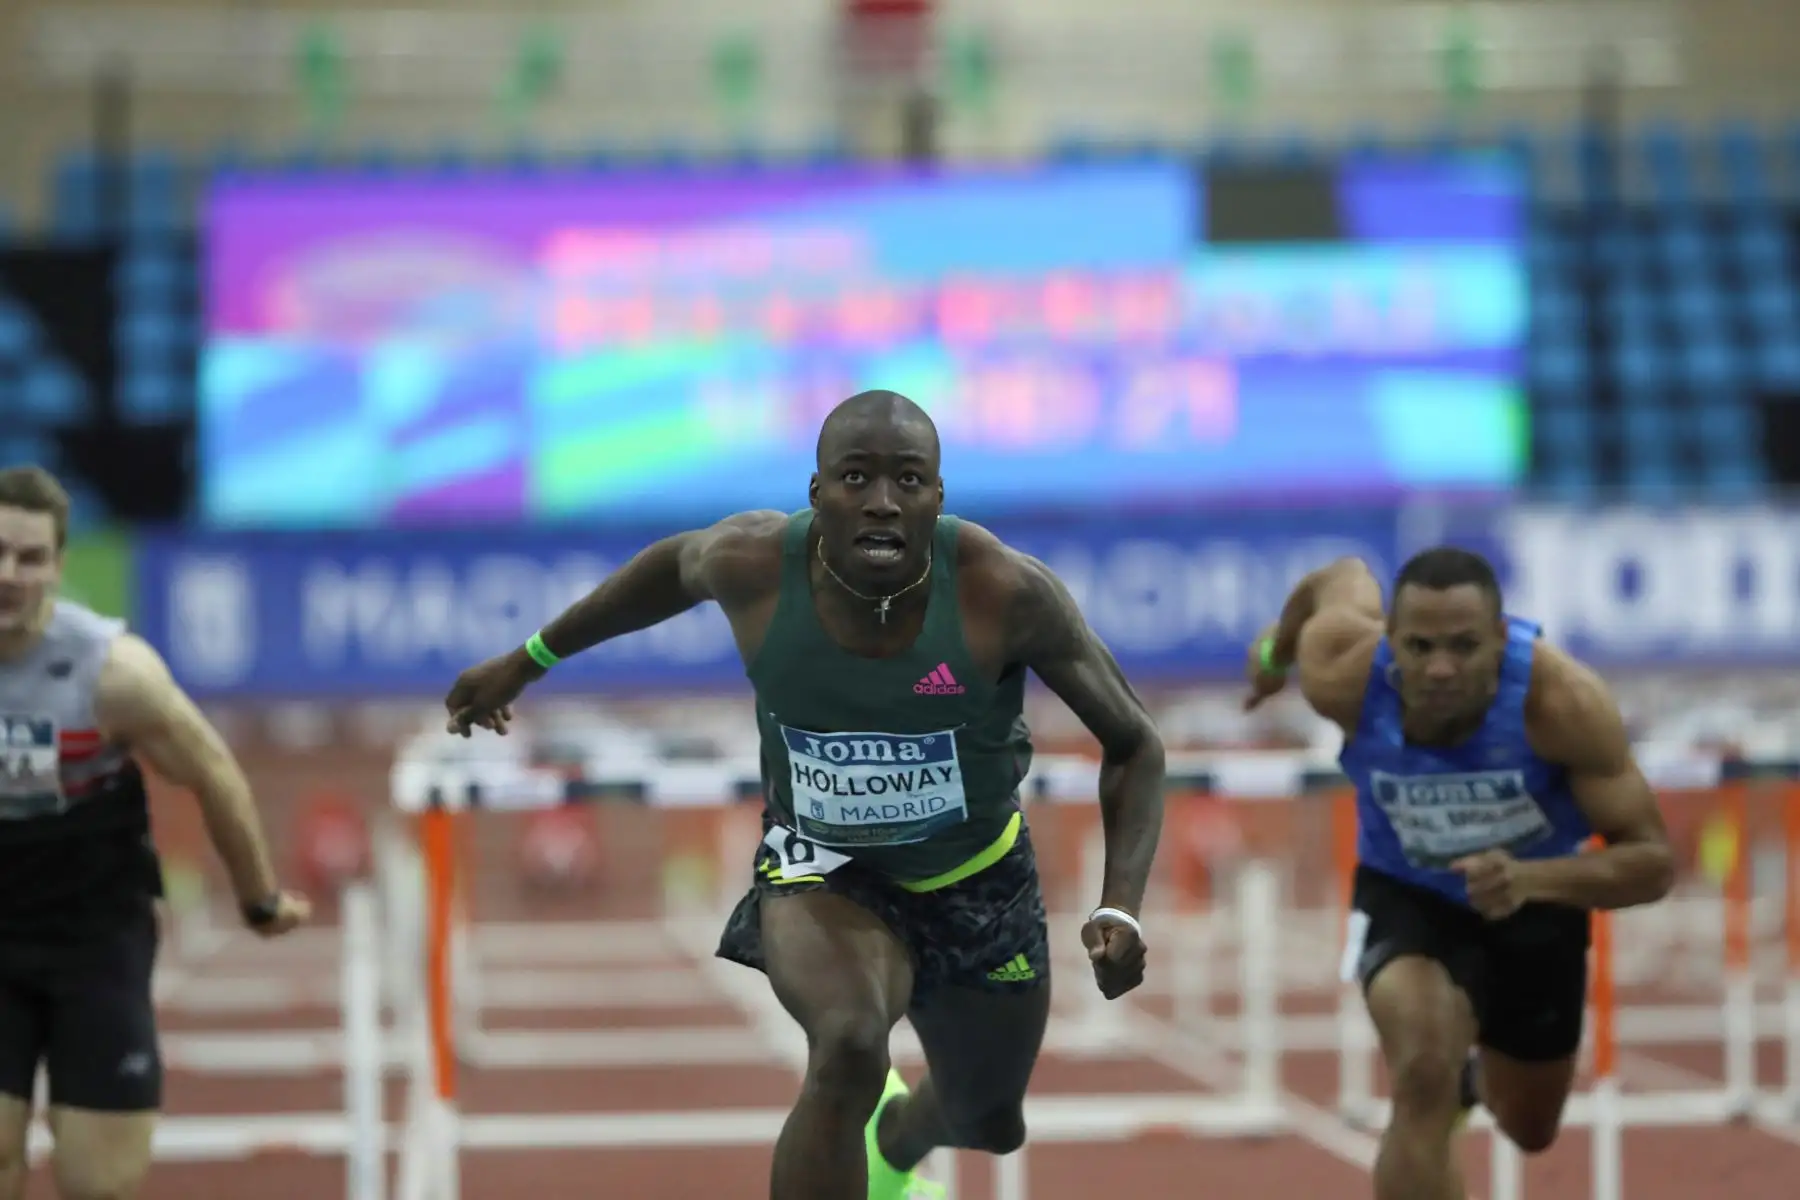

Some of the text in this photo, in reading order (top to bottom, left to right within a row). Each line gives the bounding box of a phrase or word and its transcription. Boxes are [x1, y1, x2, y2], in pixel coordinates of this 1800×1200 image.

[912, 683, 966, 695] adidas
[794, 762, 953, 796] HOLLOWAY
[841, 796, 947, 822] MADRID
